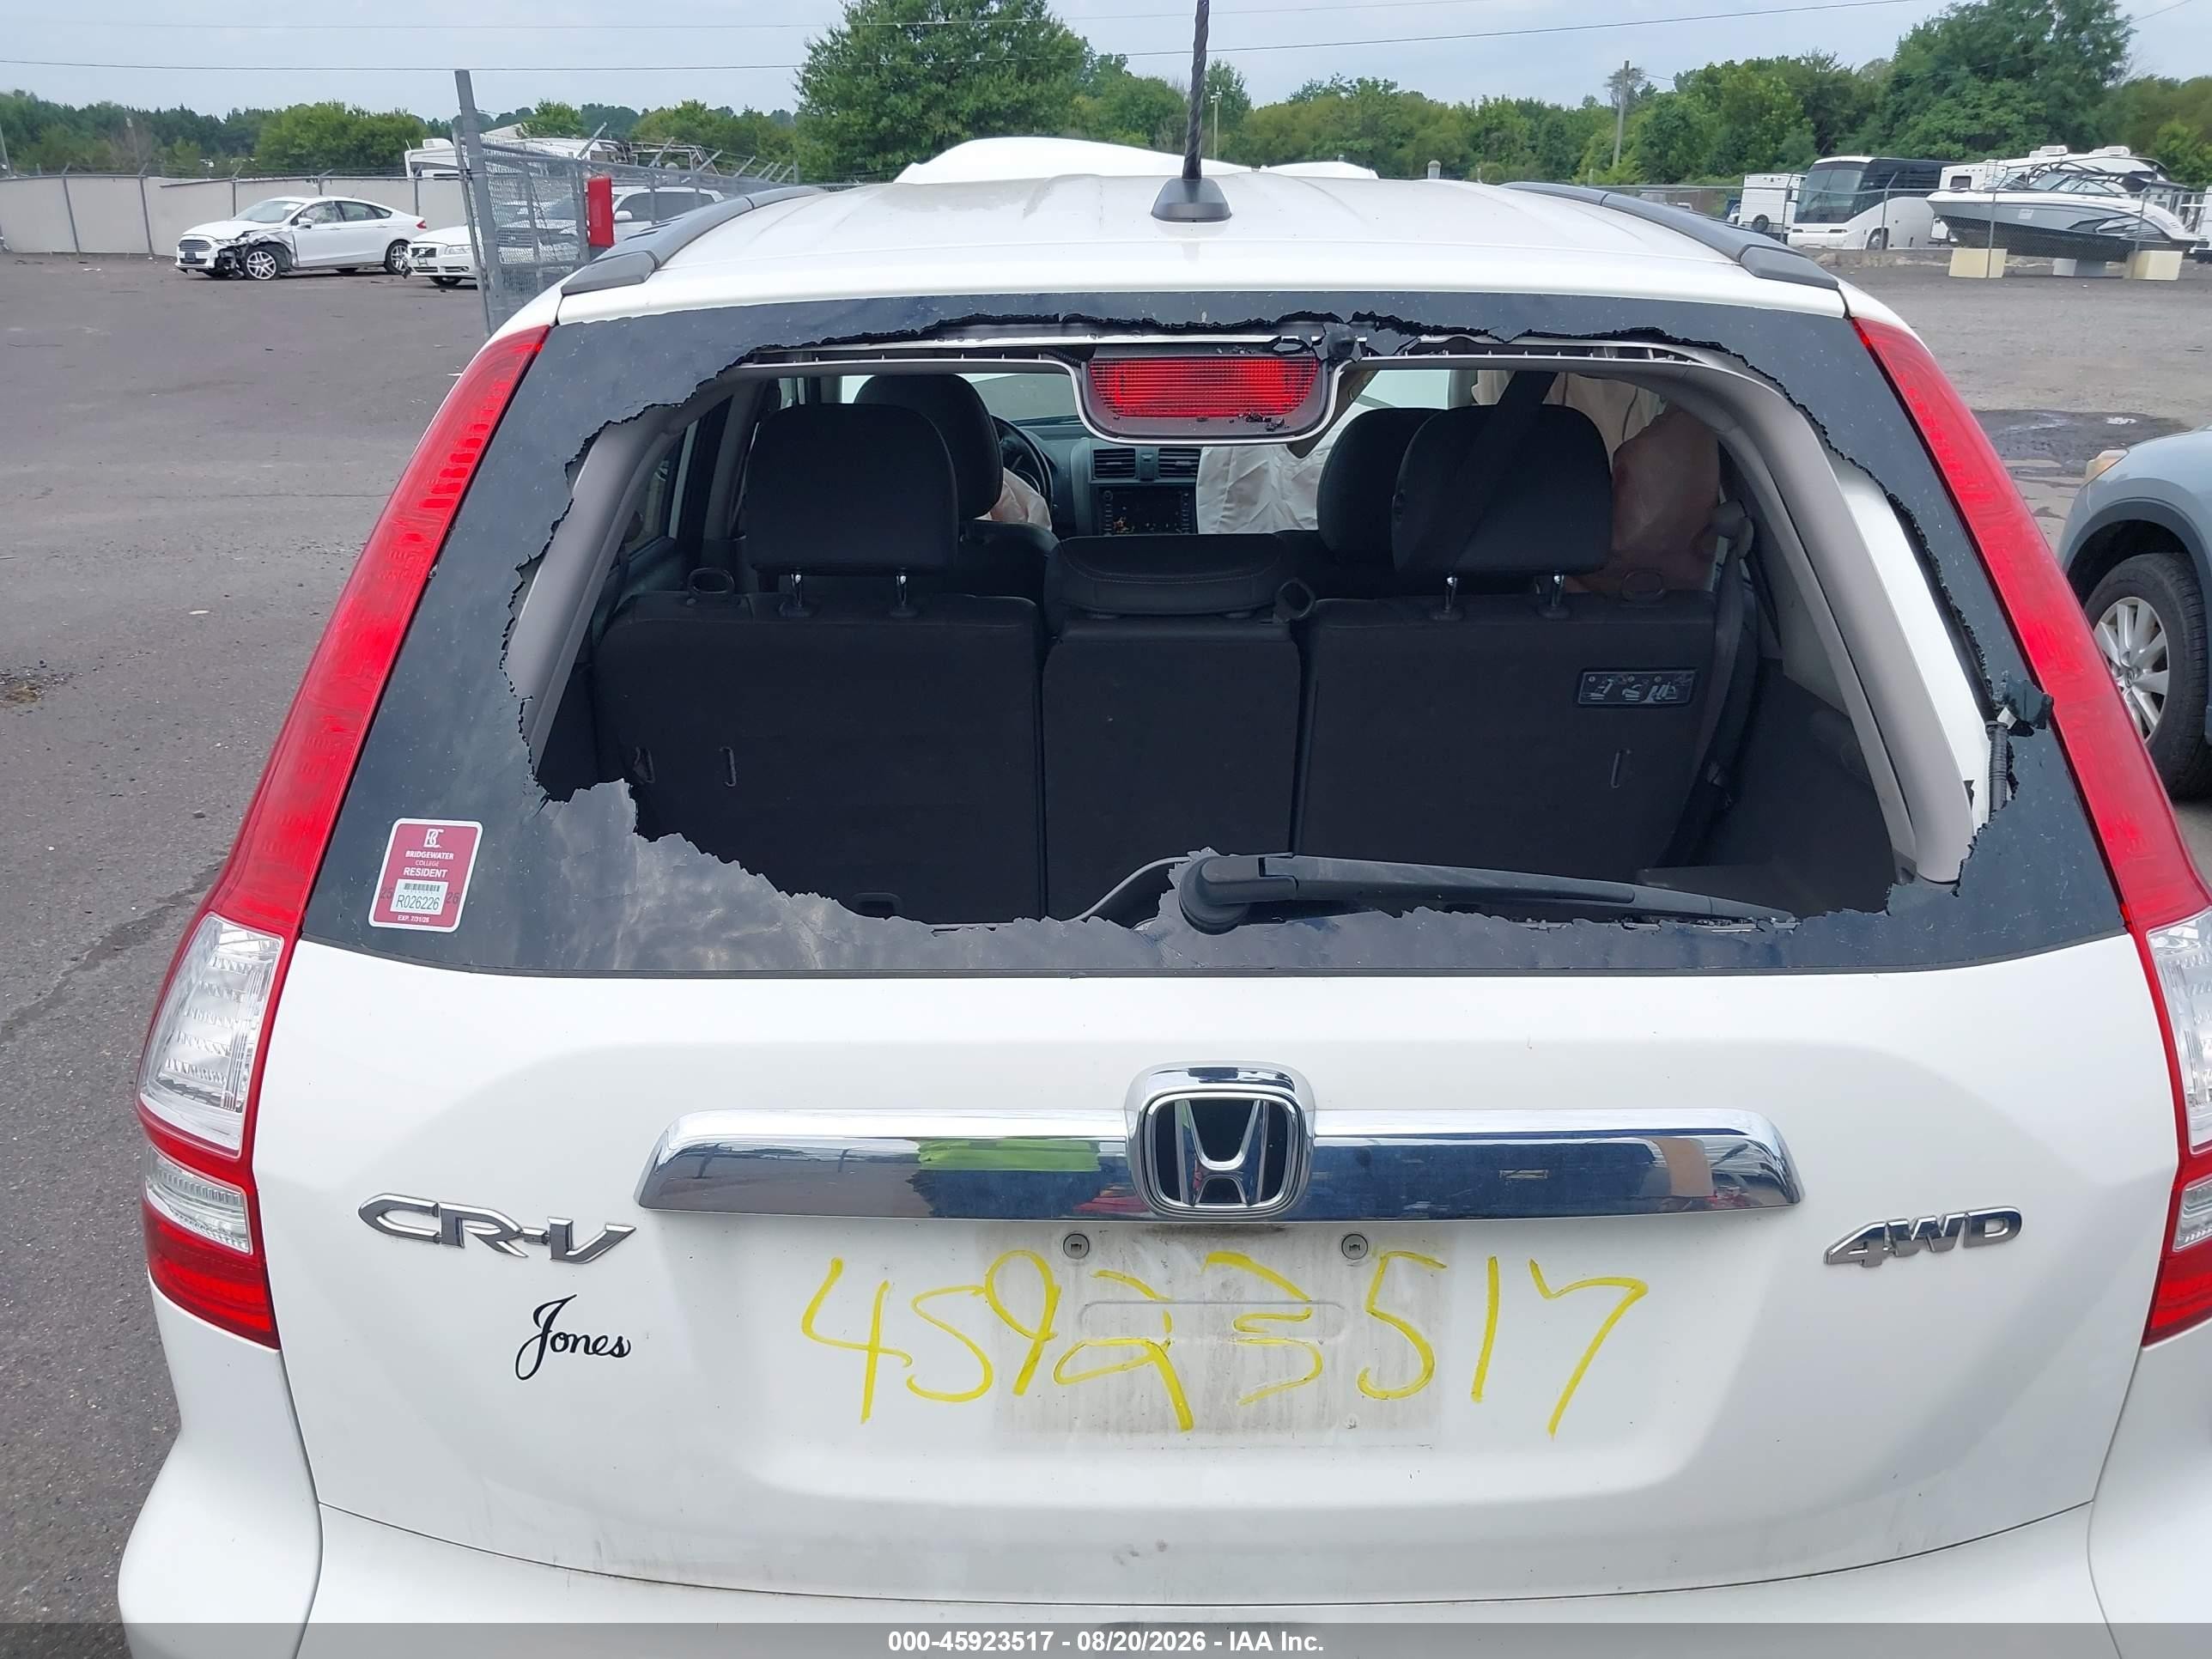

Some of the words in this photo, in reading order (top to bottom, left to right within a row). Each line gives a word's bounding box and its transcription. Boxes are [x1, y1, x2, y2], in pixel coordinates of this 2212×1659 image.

[403, 866, 448, 878] RESIDENT
[405, 850, 454, 860] BRIDGEWATER
[396, 894, 441, 911] R026226
[357, 1193, 636, 1264] CR-V
[1823, 1206, 2023, 1267] 4WD
[515, 1294, 632, 1381] Jones
